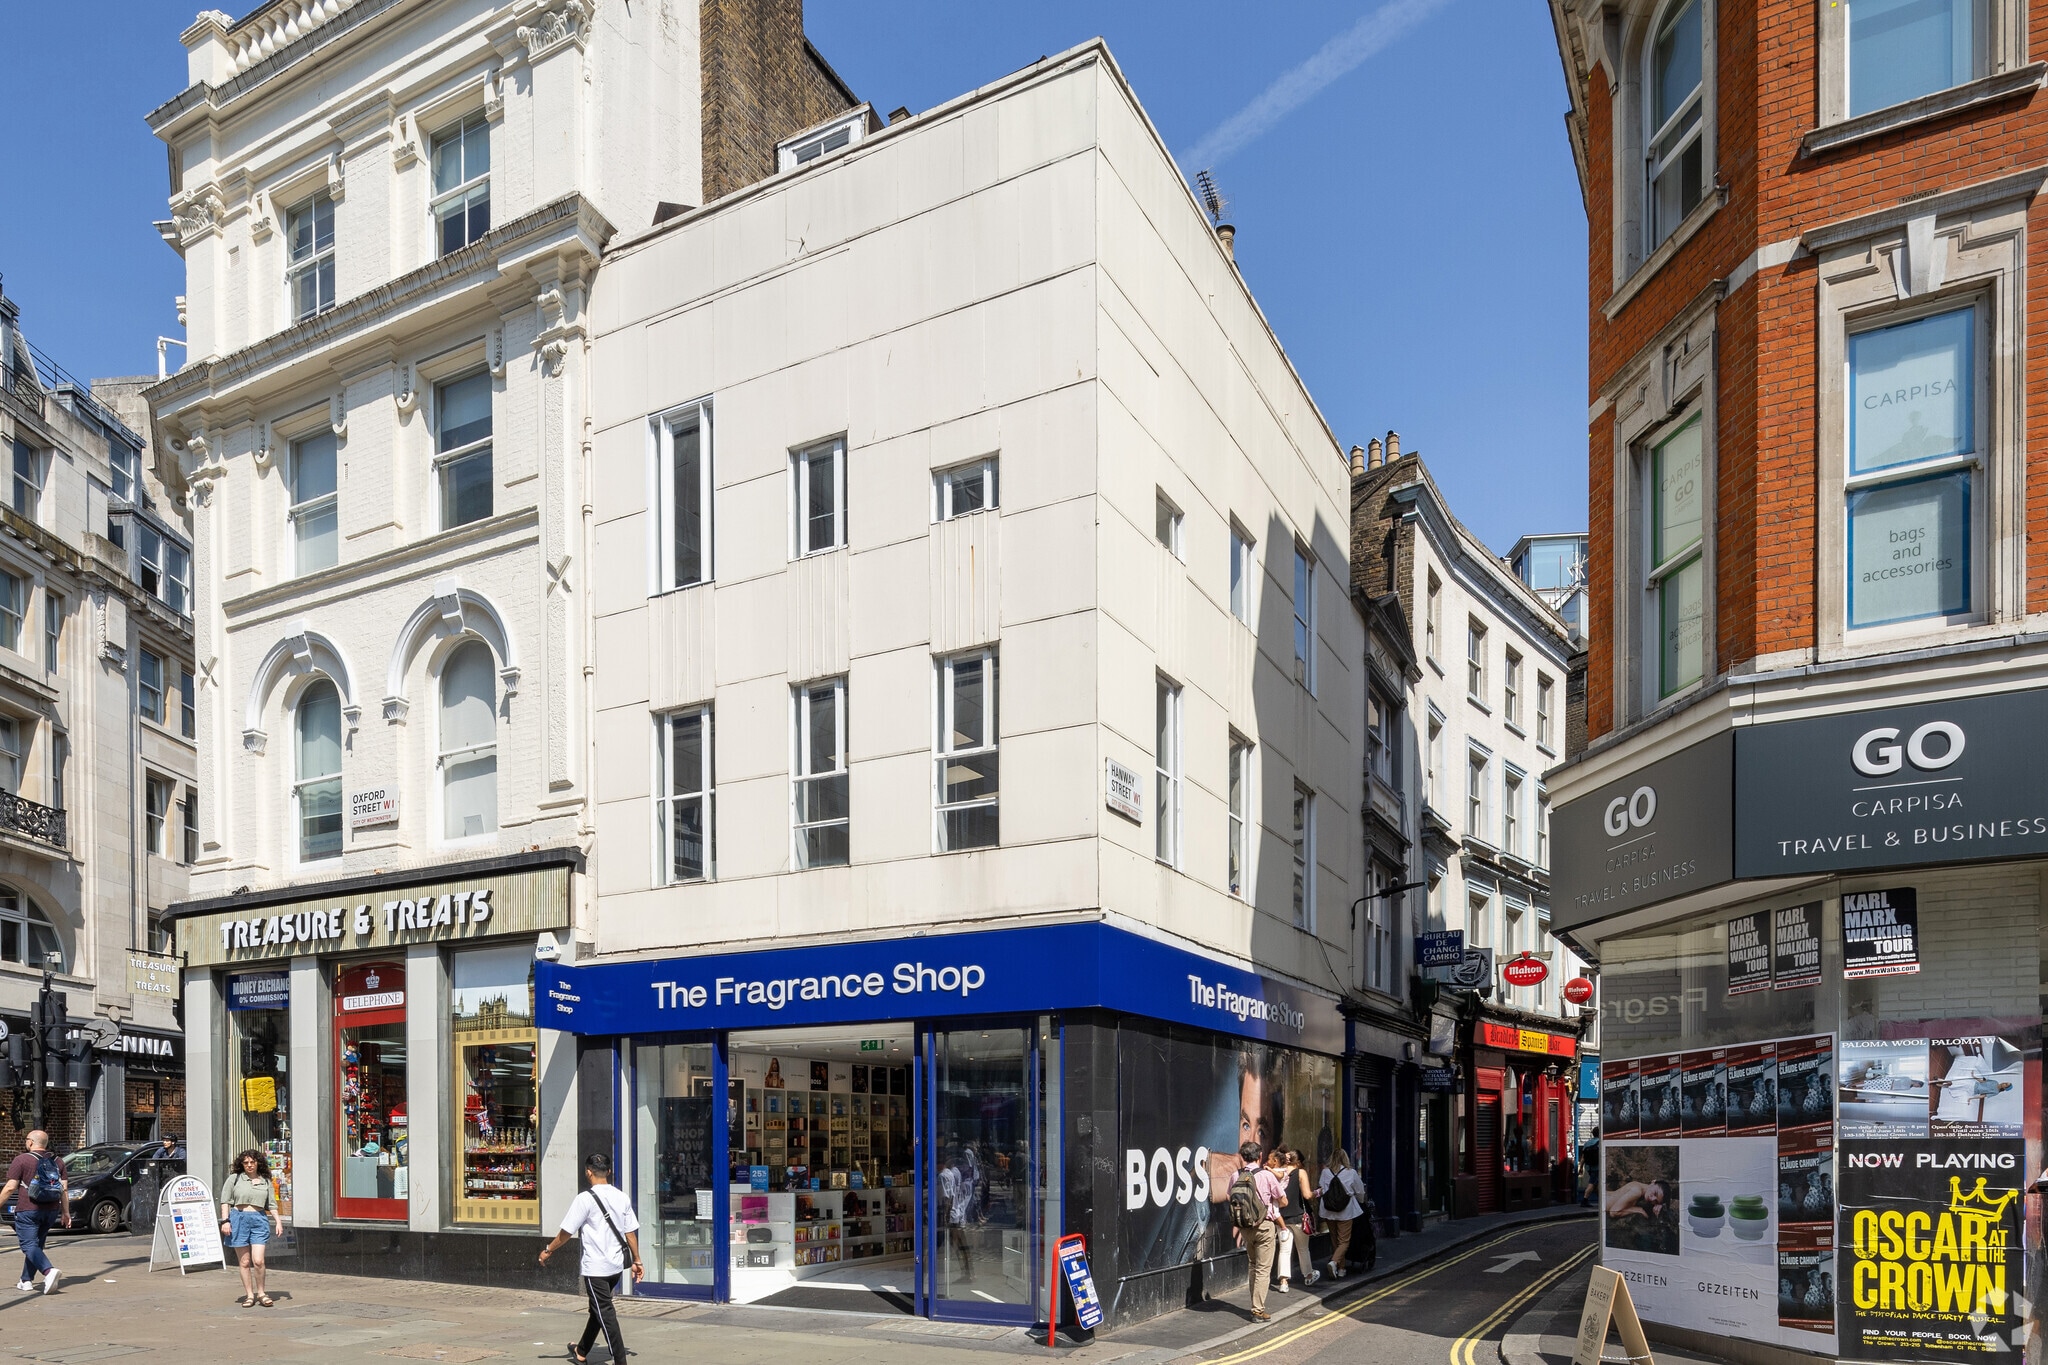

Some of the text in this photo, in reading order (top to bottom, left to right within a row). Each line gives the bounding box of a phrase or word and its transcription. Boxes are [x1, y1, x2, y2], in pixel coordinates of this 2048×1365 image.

[1863, 378, 1957, 410] CARPISA
[1660, 454, 1702, 493] CARPIS
[1674, 479, 1694, 502] GO
[1888, 526, 1926, 543] bags
[1892, 543, 1921, 560] and
[1862, 557, 1953, 583] accessories
[1851, 720, 1966, 777] GO
[1111, 763, 1135, 788] HANWAY
[352, 789, 386, 804] OXFORD
[1111, 779, 1131, 801] STREET
[352, 799, 395, 816] STREET W1
[1604, 785, 1657, 837] GO
[1852, 792, 1963, 818] CARPISA
[367, 814, 391, 823] WESTMINSTER
[1777, 817, 2047, 857] TRAVEL & BUSINESS
[1605, 844, 1657, 874] CARPISA
[1573, 859, 1696, 909] TRAVEL & BUSINESS
[1844, 891, 1890, 912] KARL
[220, 889, 492, 950] TREASURE & TREATS
[1776, 906, 1805, 928] KARL
[1844, 908, 1897, 929] MARX
[1729, 916, 1755, 937] KARL
[1776, 922, 1810, 944] MARX
[1845, 923, 1912, 942] WALKING
[1424, 931, 1460, 940] BUREAU
[1730, 930, 1759, 951] MARX
[1423, 945, 1460, 955] CHANGE
[1730, 944, 1768, 964] WALKING
[1776, 937, 1818, 957] WALKING
[1873, 938, 1913, 954] TOUR
[1424, 952, 1460, 962] CAMBIO
[1745, 957, 1768, 973] TOUR
[1794, 951, 1819, 967] TOUR
[130, 958, 176, 974] TREASURE
[1508, 965, 1542, 975] Mahou
[1847, 965, 1915, 977] www.MarxWalks.com
[149, 973, 155, 981] &
[559, 980, 571, 991] The
[135, 981, 171, 993] TREATS
[232, 981, 257, 996] MONEY
[258, 977, 290, 994] EXCHANG
[651, 961, 986, 1011] The Fragrance Shop
[238, 992, 289, 1004] 0% COMMISSION
[346, 992, 401, 1009] TELEPHONE
[549, 989, 580, 1002] Fragrance
[1187, 974, 1305, 1034] The Fragrance Shop
[556, 1003, 573, 1014] Shop
[1521, 1031, 1546, 1050] Spanish
[1841, 1039, 1927, 1048] PALOMA WOOL
[1931, 1037, 1981, 1046] PALOMA
[1779, 1059, 1819, 1075] CLAUDE CAHUN?
[673, 1128, 705, 1139] SHOP
[675, 1140, 705, 1151] NOW
[677, 1152, 701, 1163] PAY
[1779, 1157, 1820, 1170] CLAUDE CAHUN?
[1848, 1153, 2015, 1168] NOW PLAYING
[672, 1165, 706, 1176] LATER
[1126, 1145, 1210, 1211] BOSS
[1853, 1209, 1988, 1262] OSCAR
[1988, 1229, 2009, 1247] AT
[1780, 1255, 1820, 1265] CLAUDE CAHUN?
[1988, 1247, 2006, 1264] THE
[1590, 1287, 1610, 1303] BAKERY
[1697, 1281, 1759, 1300] GEZEITEN
[1853, 1259, 2006, 1316] CROWN
[1870, 1311, 1909, 1319] DYSTOPIAN
[1912, 1312, 1936, 1320] DANCE
[1938, 1314, 1963, 1322] PARTY
[1912, 1331, 1943, 1339] PEOPLE,
